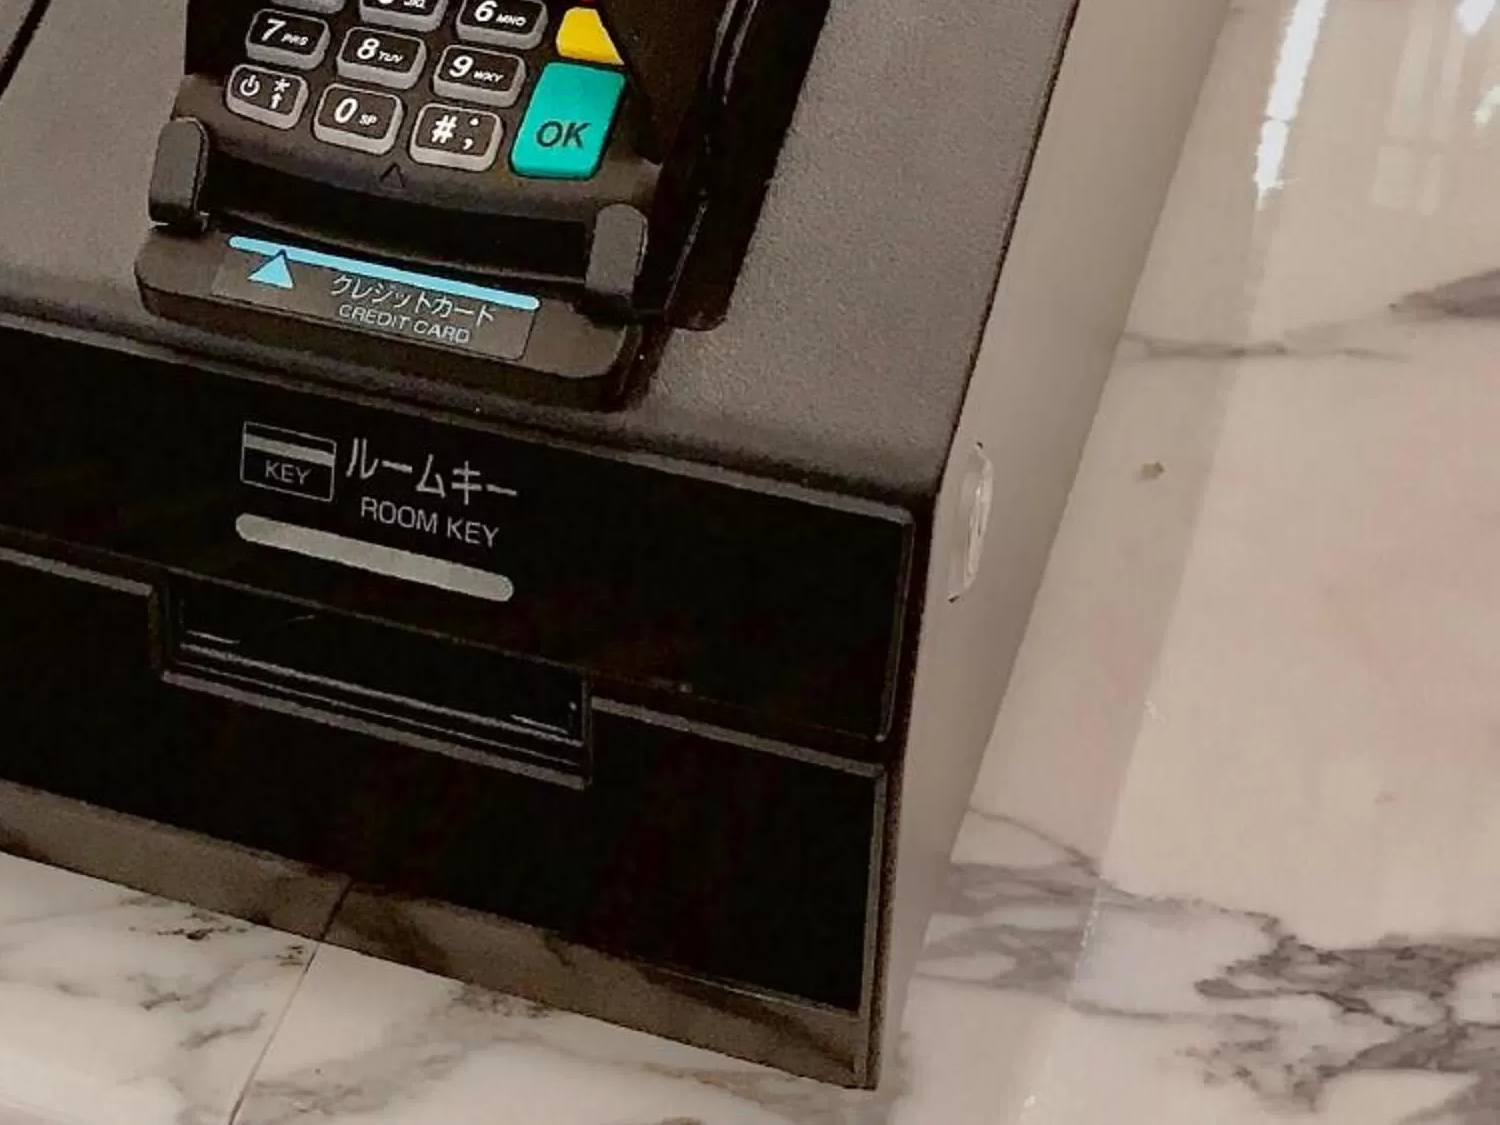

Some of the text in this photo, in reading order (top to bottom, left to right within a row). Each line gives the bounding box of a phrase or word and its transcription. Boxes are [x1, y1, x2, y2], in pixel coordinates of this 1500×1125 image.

[474, 0, 499, 22] 6
[261, 18, 287, 42] 7
[356, 38, 380, 60] 8
[448, 55, 474, 78] 9
[334, 97, 358, 124] 0
[536, 120, 592, 148] OK
[330, 274, 496, 327] クレジットカード
[338, 303, 472, 345] CREDIT CARD
[264, 459, 312, 486] KEY
[345, 437, 518, 506] ルームキー
[360, 495, 500, 549] ROOM KEY
